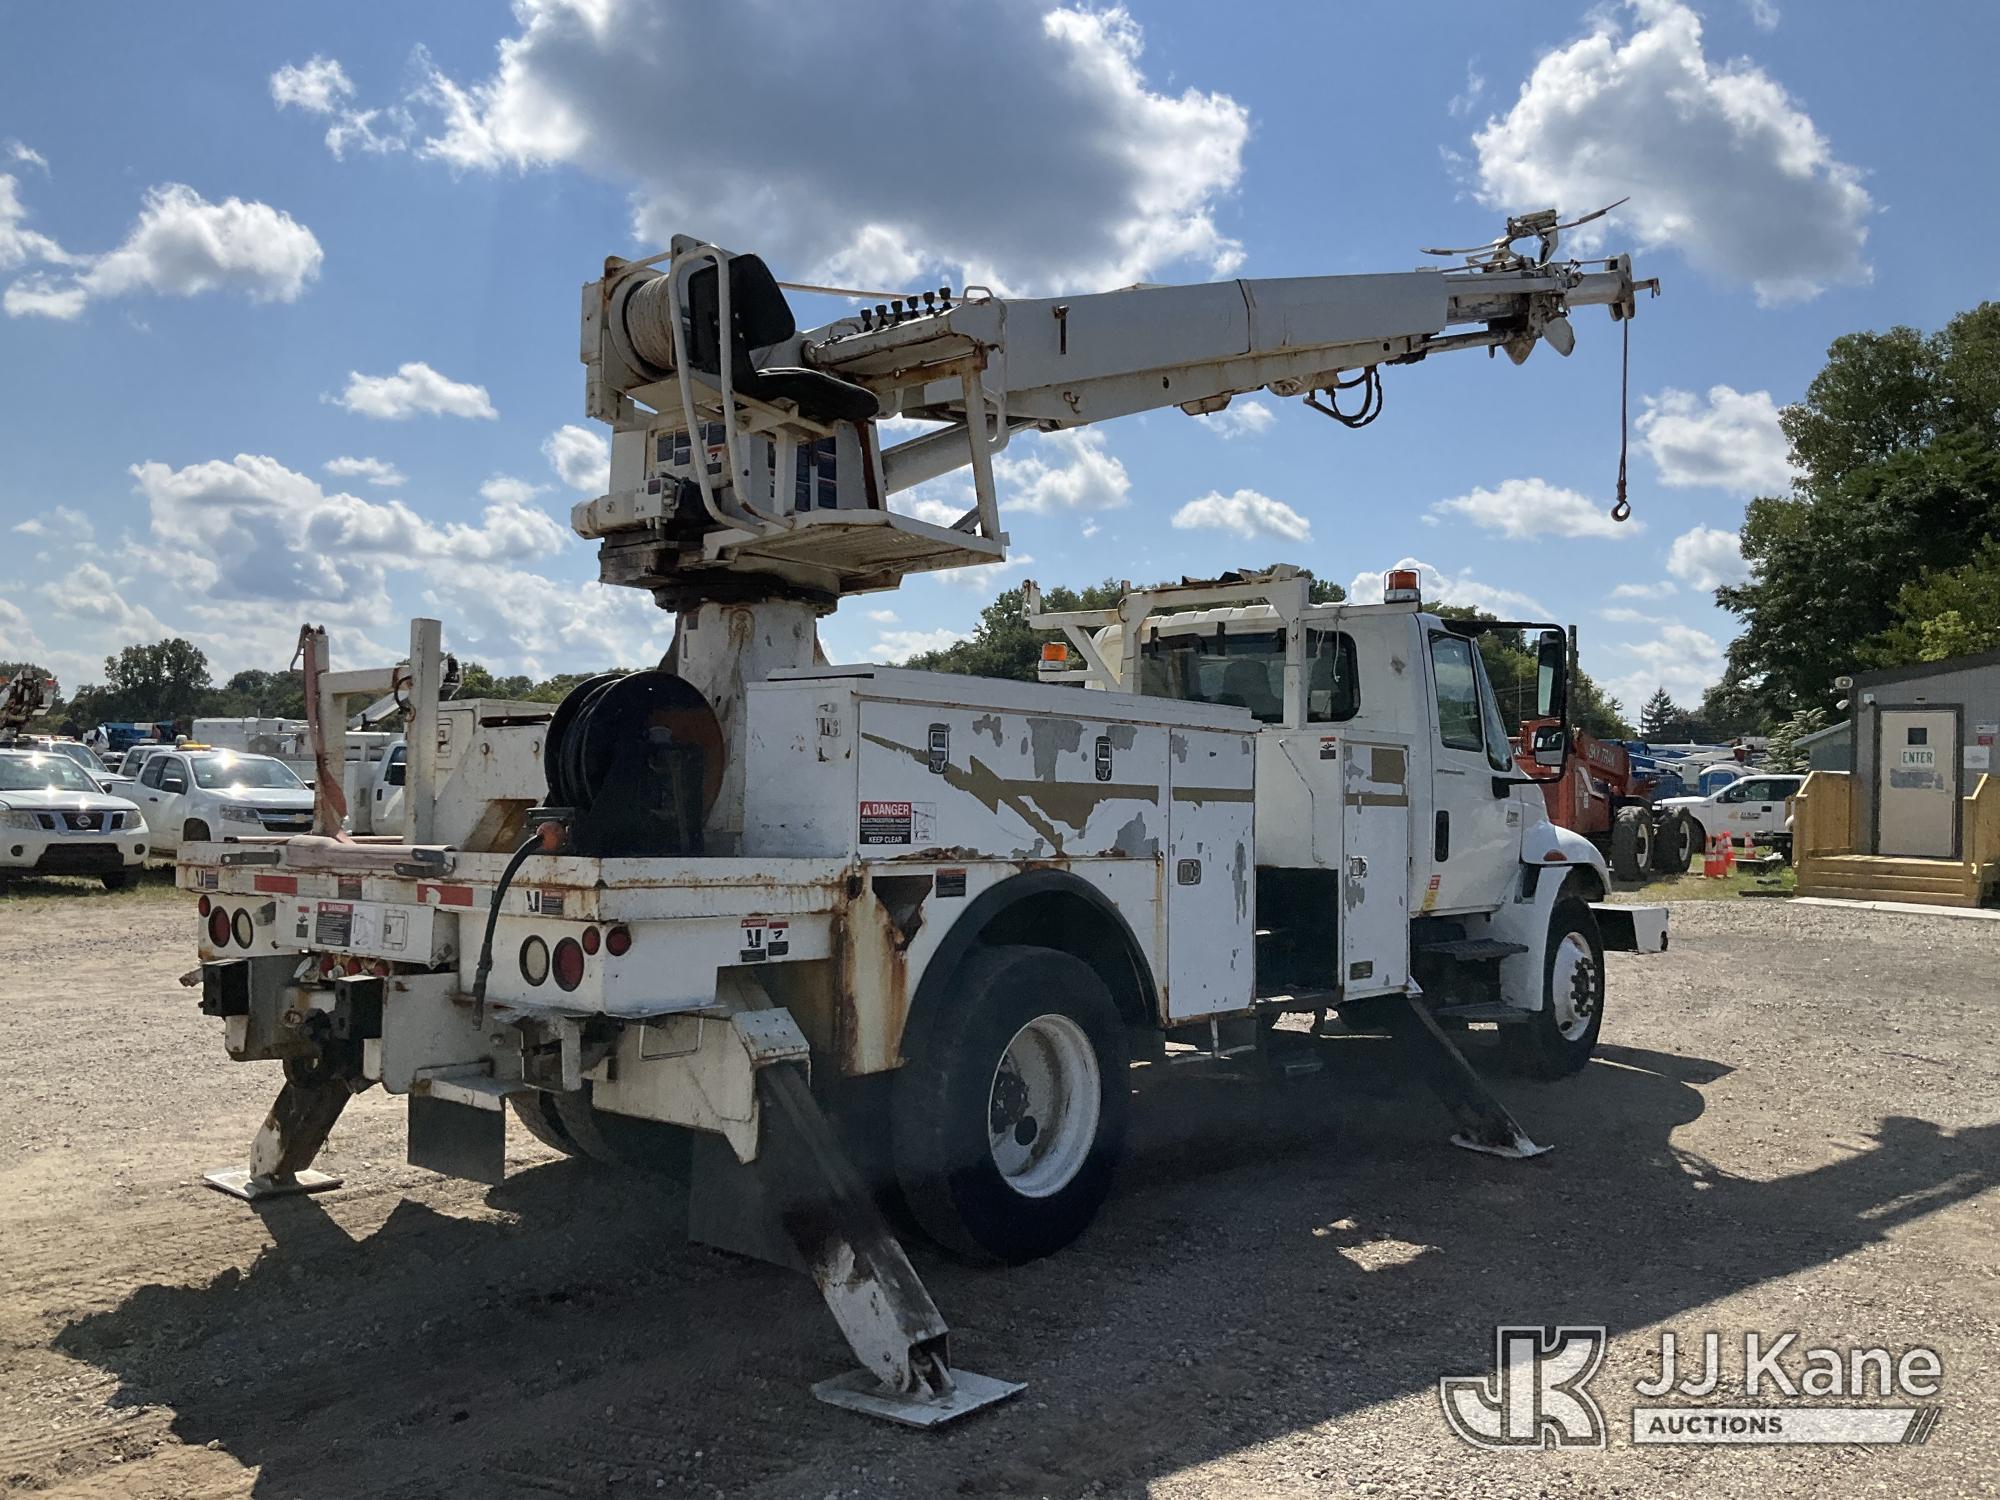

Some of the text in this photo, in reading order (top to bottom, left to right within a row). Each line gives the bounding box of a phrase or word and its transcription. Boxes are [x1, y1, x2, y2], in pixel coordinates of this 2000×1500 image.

[1902, 751, 1933, 764] ENTER
[872, 803, 909, 816] DANGER
[868, 836, 903, 844] KEEP CLEAR
